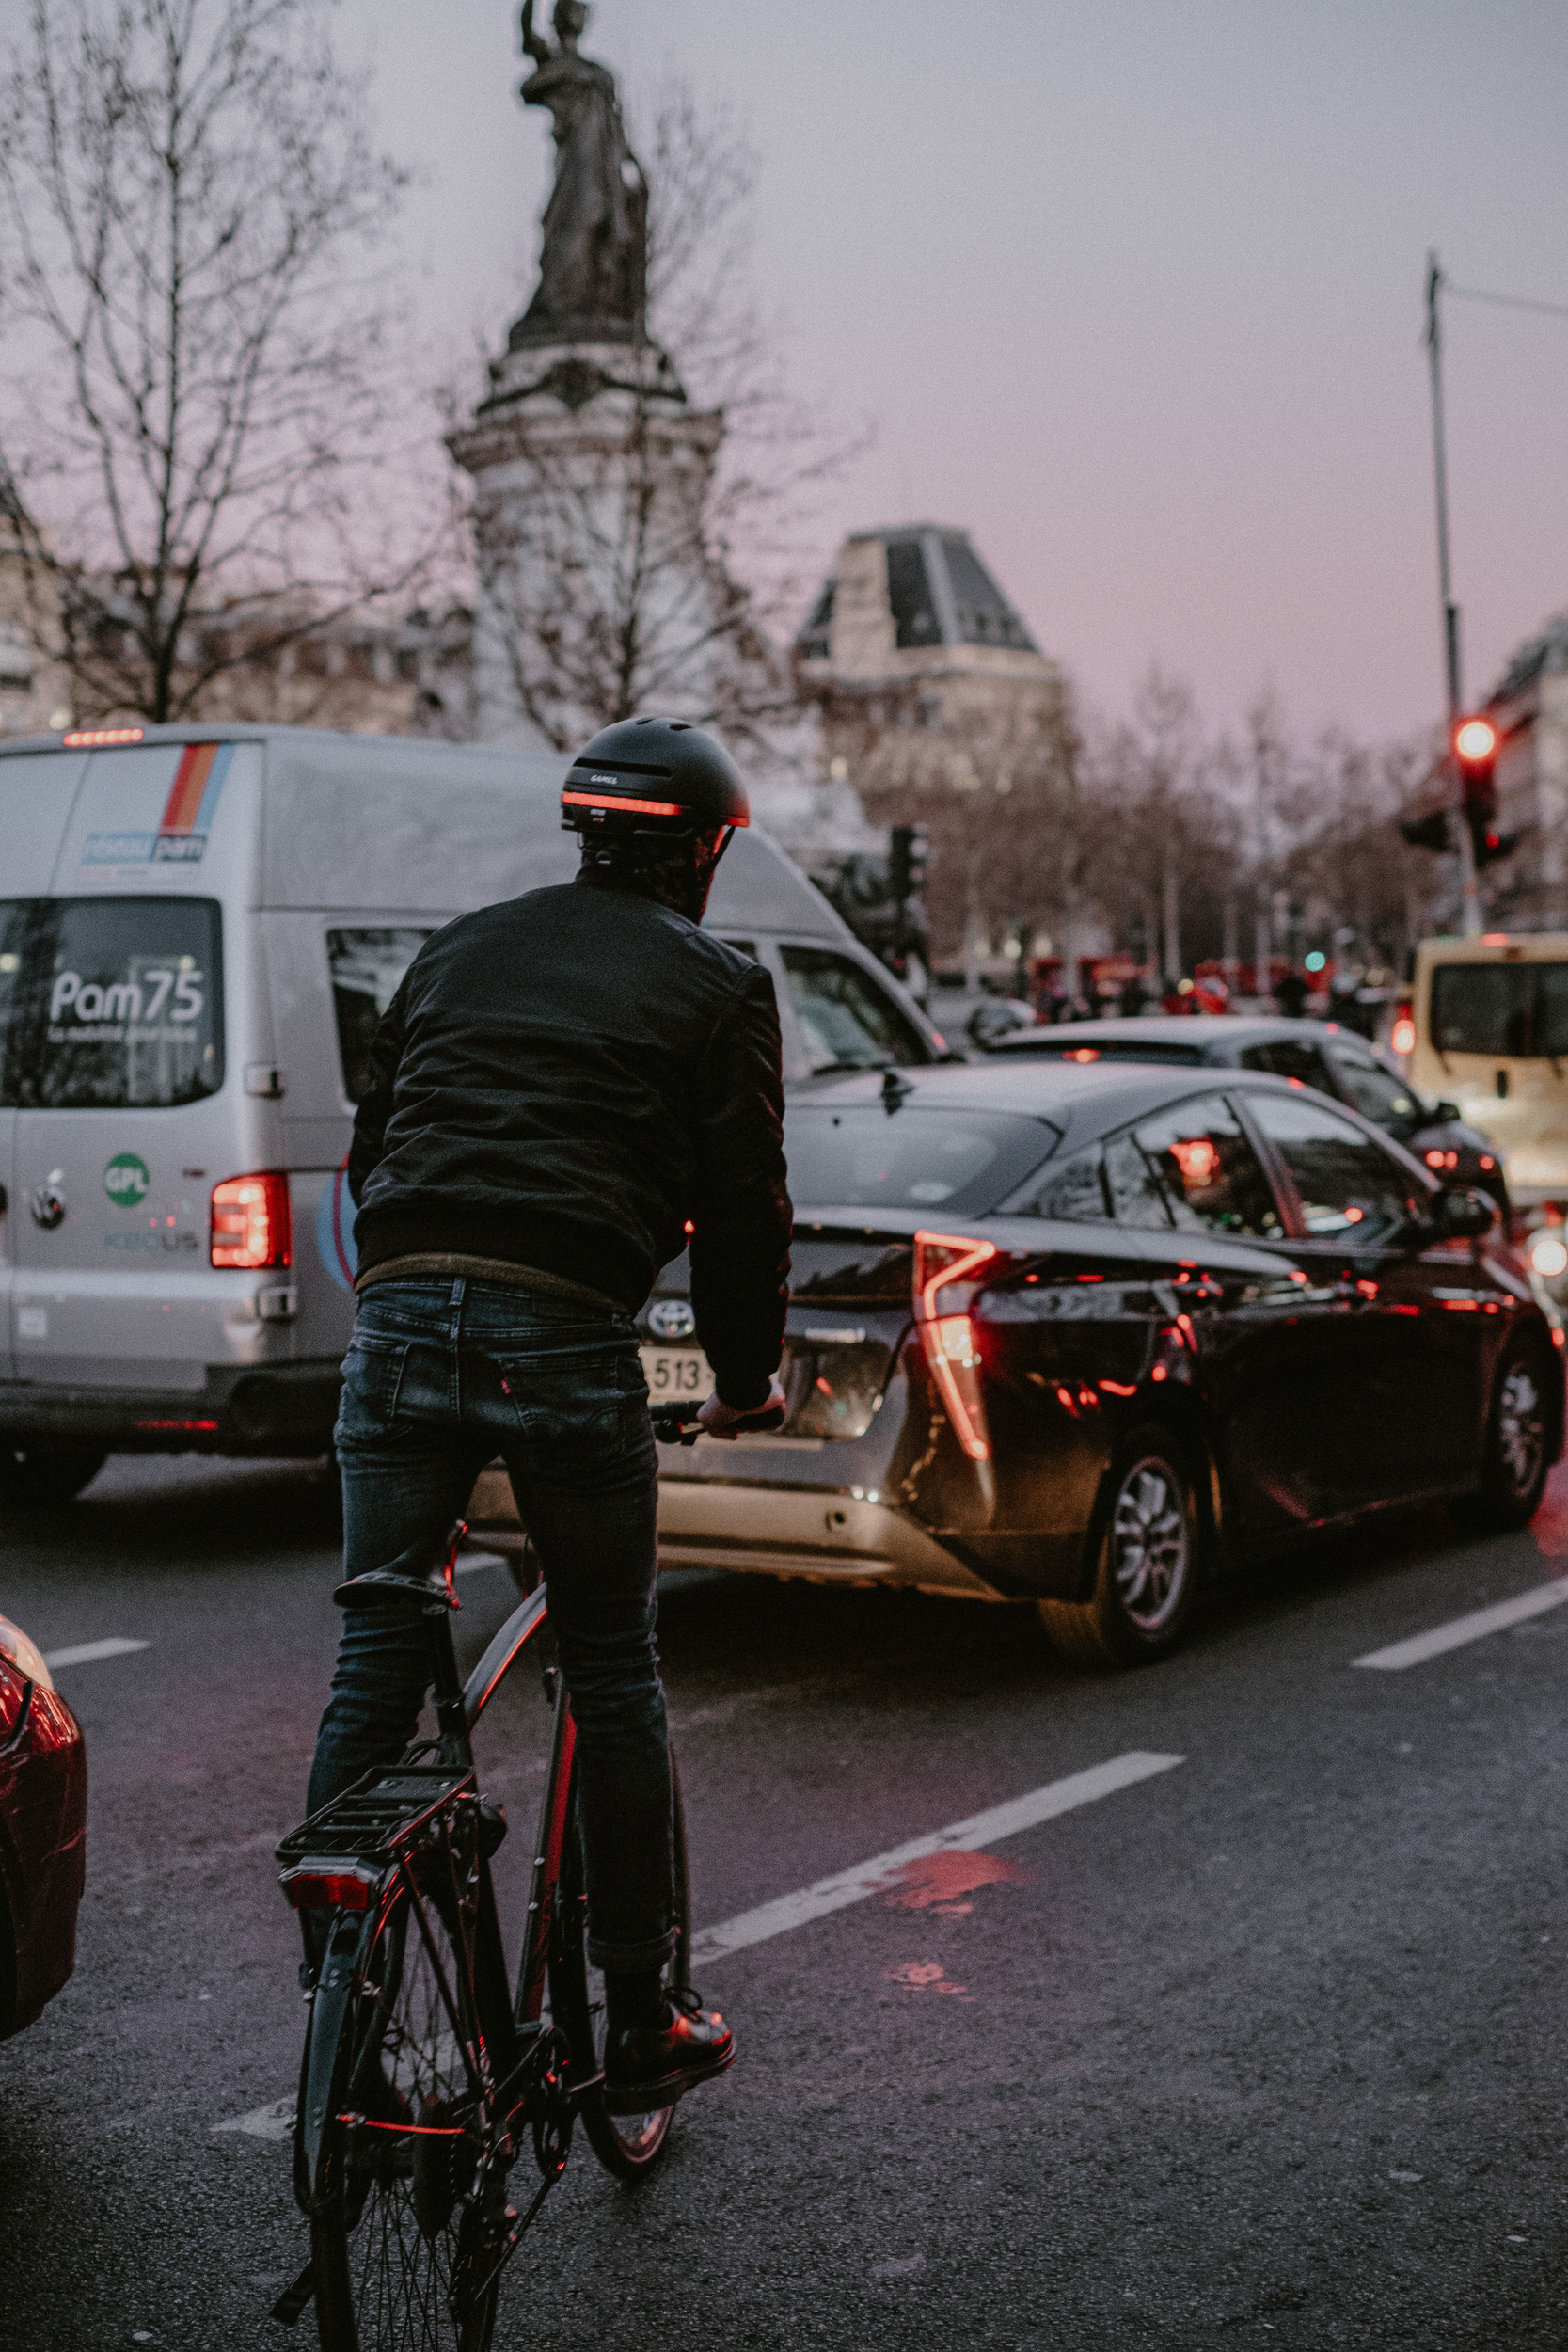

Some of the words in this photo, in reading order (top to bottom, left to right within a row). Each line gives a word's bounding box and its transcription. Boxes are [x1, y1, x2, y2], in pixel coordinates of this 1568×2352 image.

[50, 970, 204, 1023] Pam75
[105, 1167, 149, 1193] GPL
[654, 1358, 700, 1391] 513
